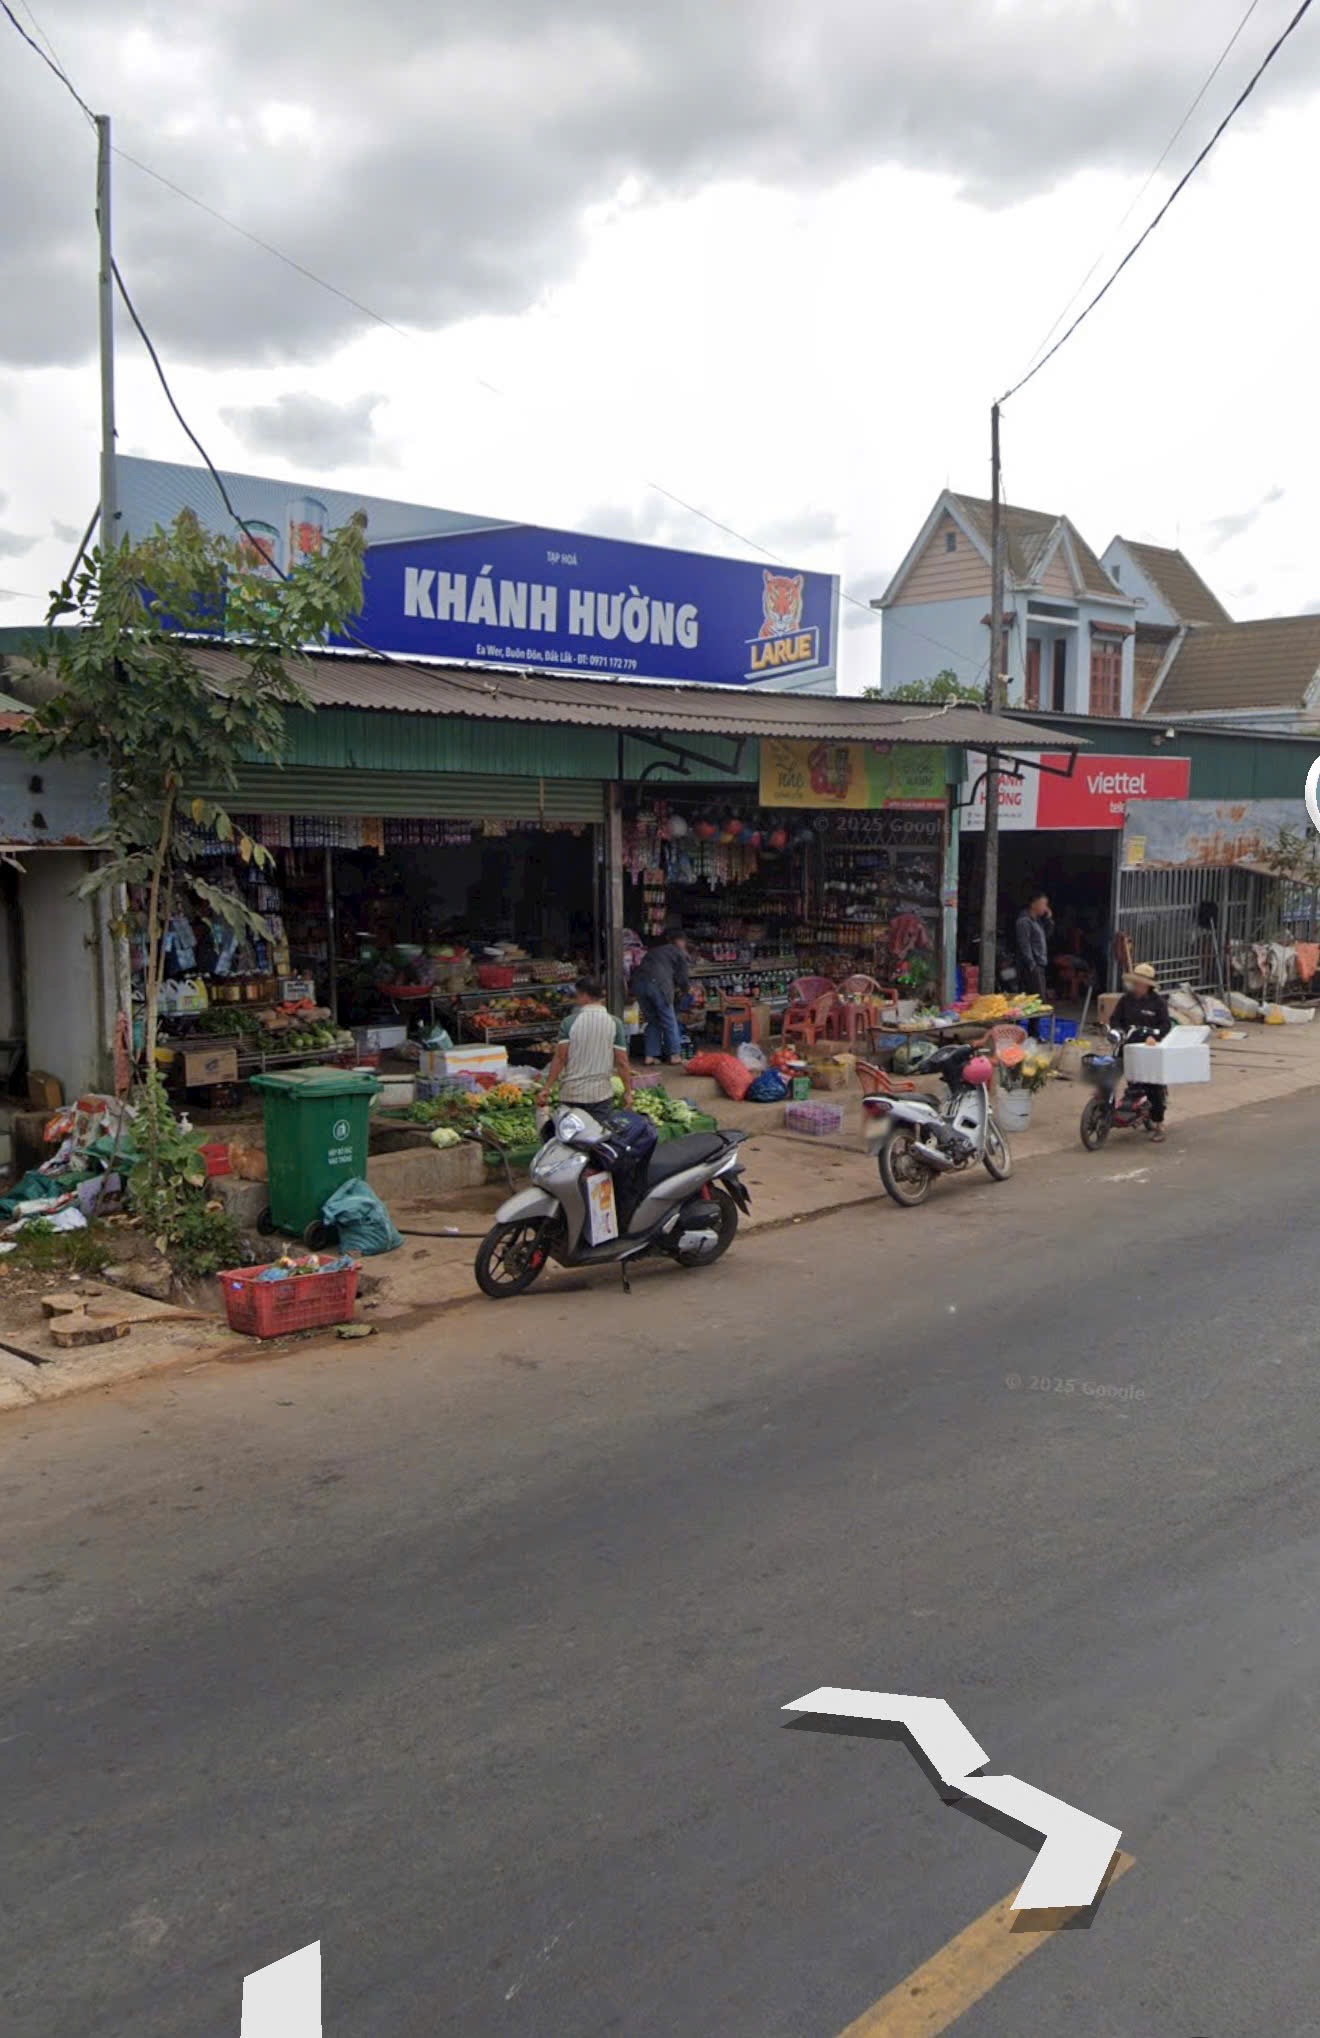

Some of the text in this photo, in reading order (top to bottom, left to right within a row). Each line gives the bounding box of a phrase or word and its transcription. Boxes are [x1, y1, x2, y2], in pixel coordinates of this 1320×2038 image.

[404, 564, 698, 649] KHÁNH HƯỜNG
[589, 655, 607, 667] 0971
[609, 656, 623, 669] 172
[623, 658, 638, 670] 779
[751, 634, 811, 670] LARUE
[1087, 772, 1147, 795] viettel
